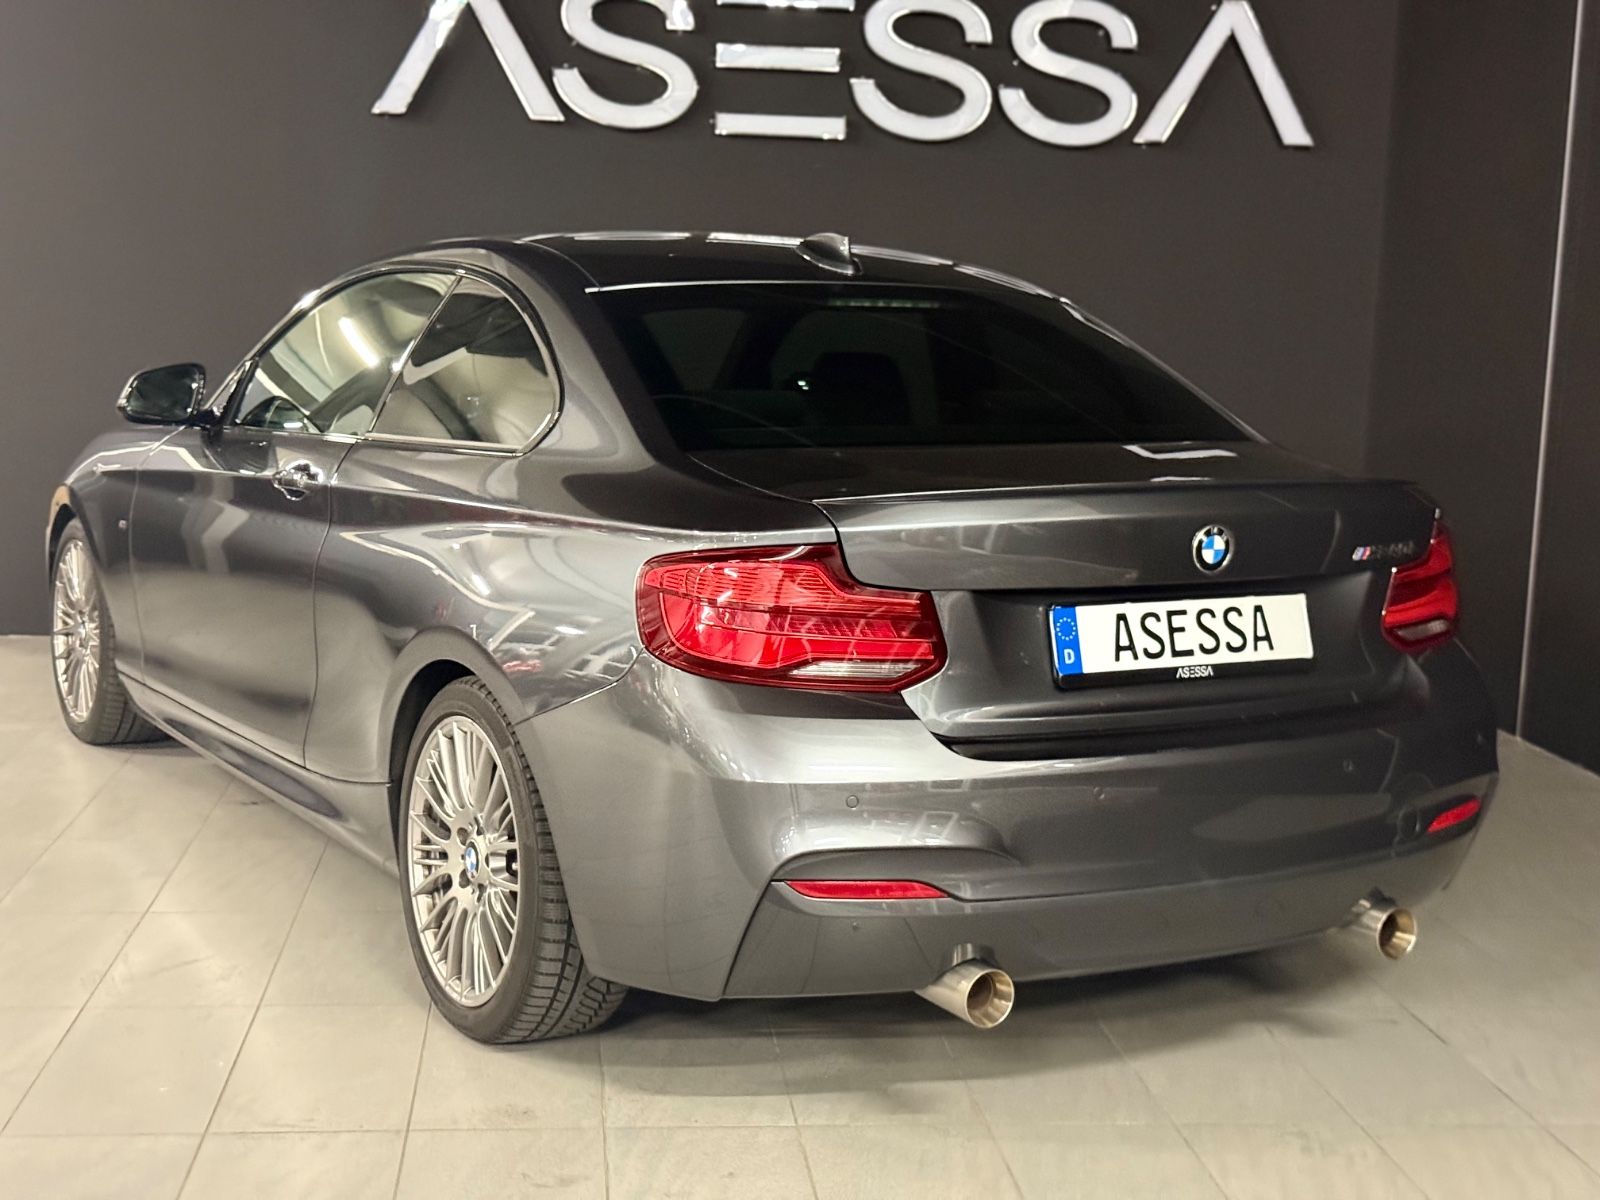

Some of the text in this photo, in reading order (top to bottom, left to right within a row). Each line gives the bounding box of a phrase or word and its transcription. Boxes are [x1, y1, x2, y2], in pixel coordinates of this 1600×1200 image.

[371, 0, 1313, 147] ASESSA
[1115, 604, 1274, 662] ASESSA
[1063, 648, 1076, 664] D
[1176, 665, 1214, 679] ASESSA
